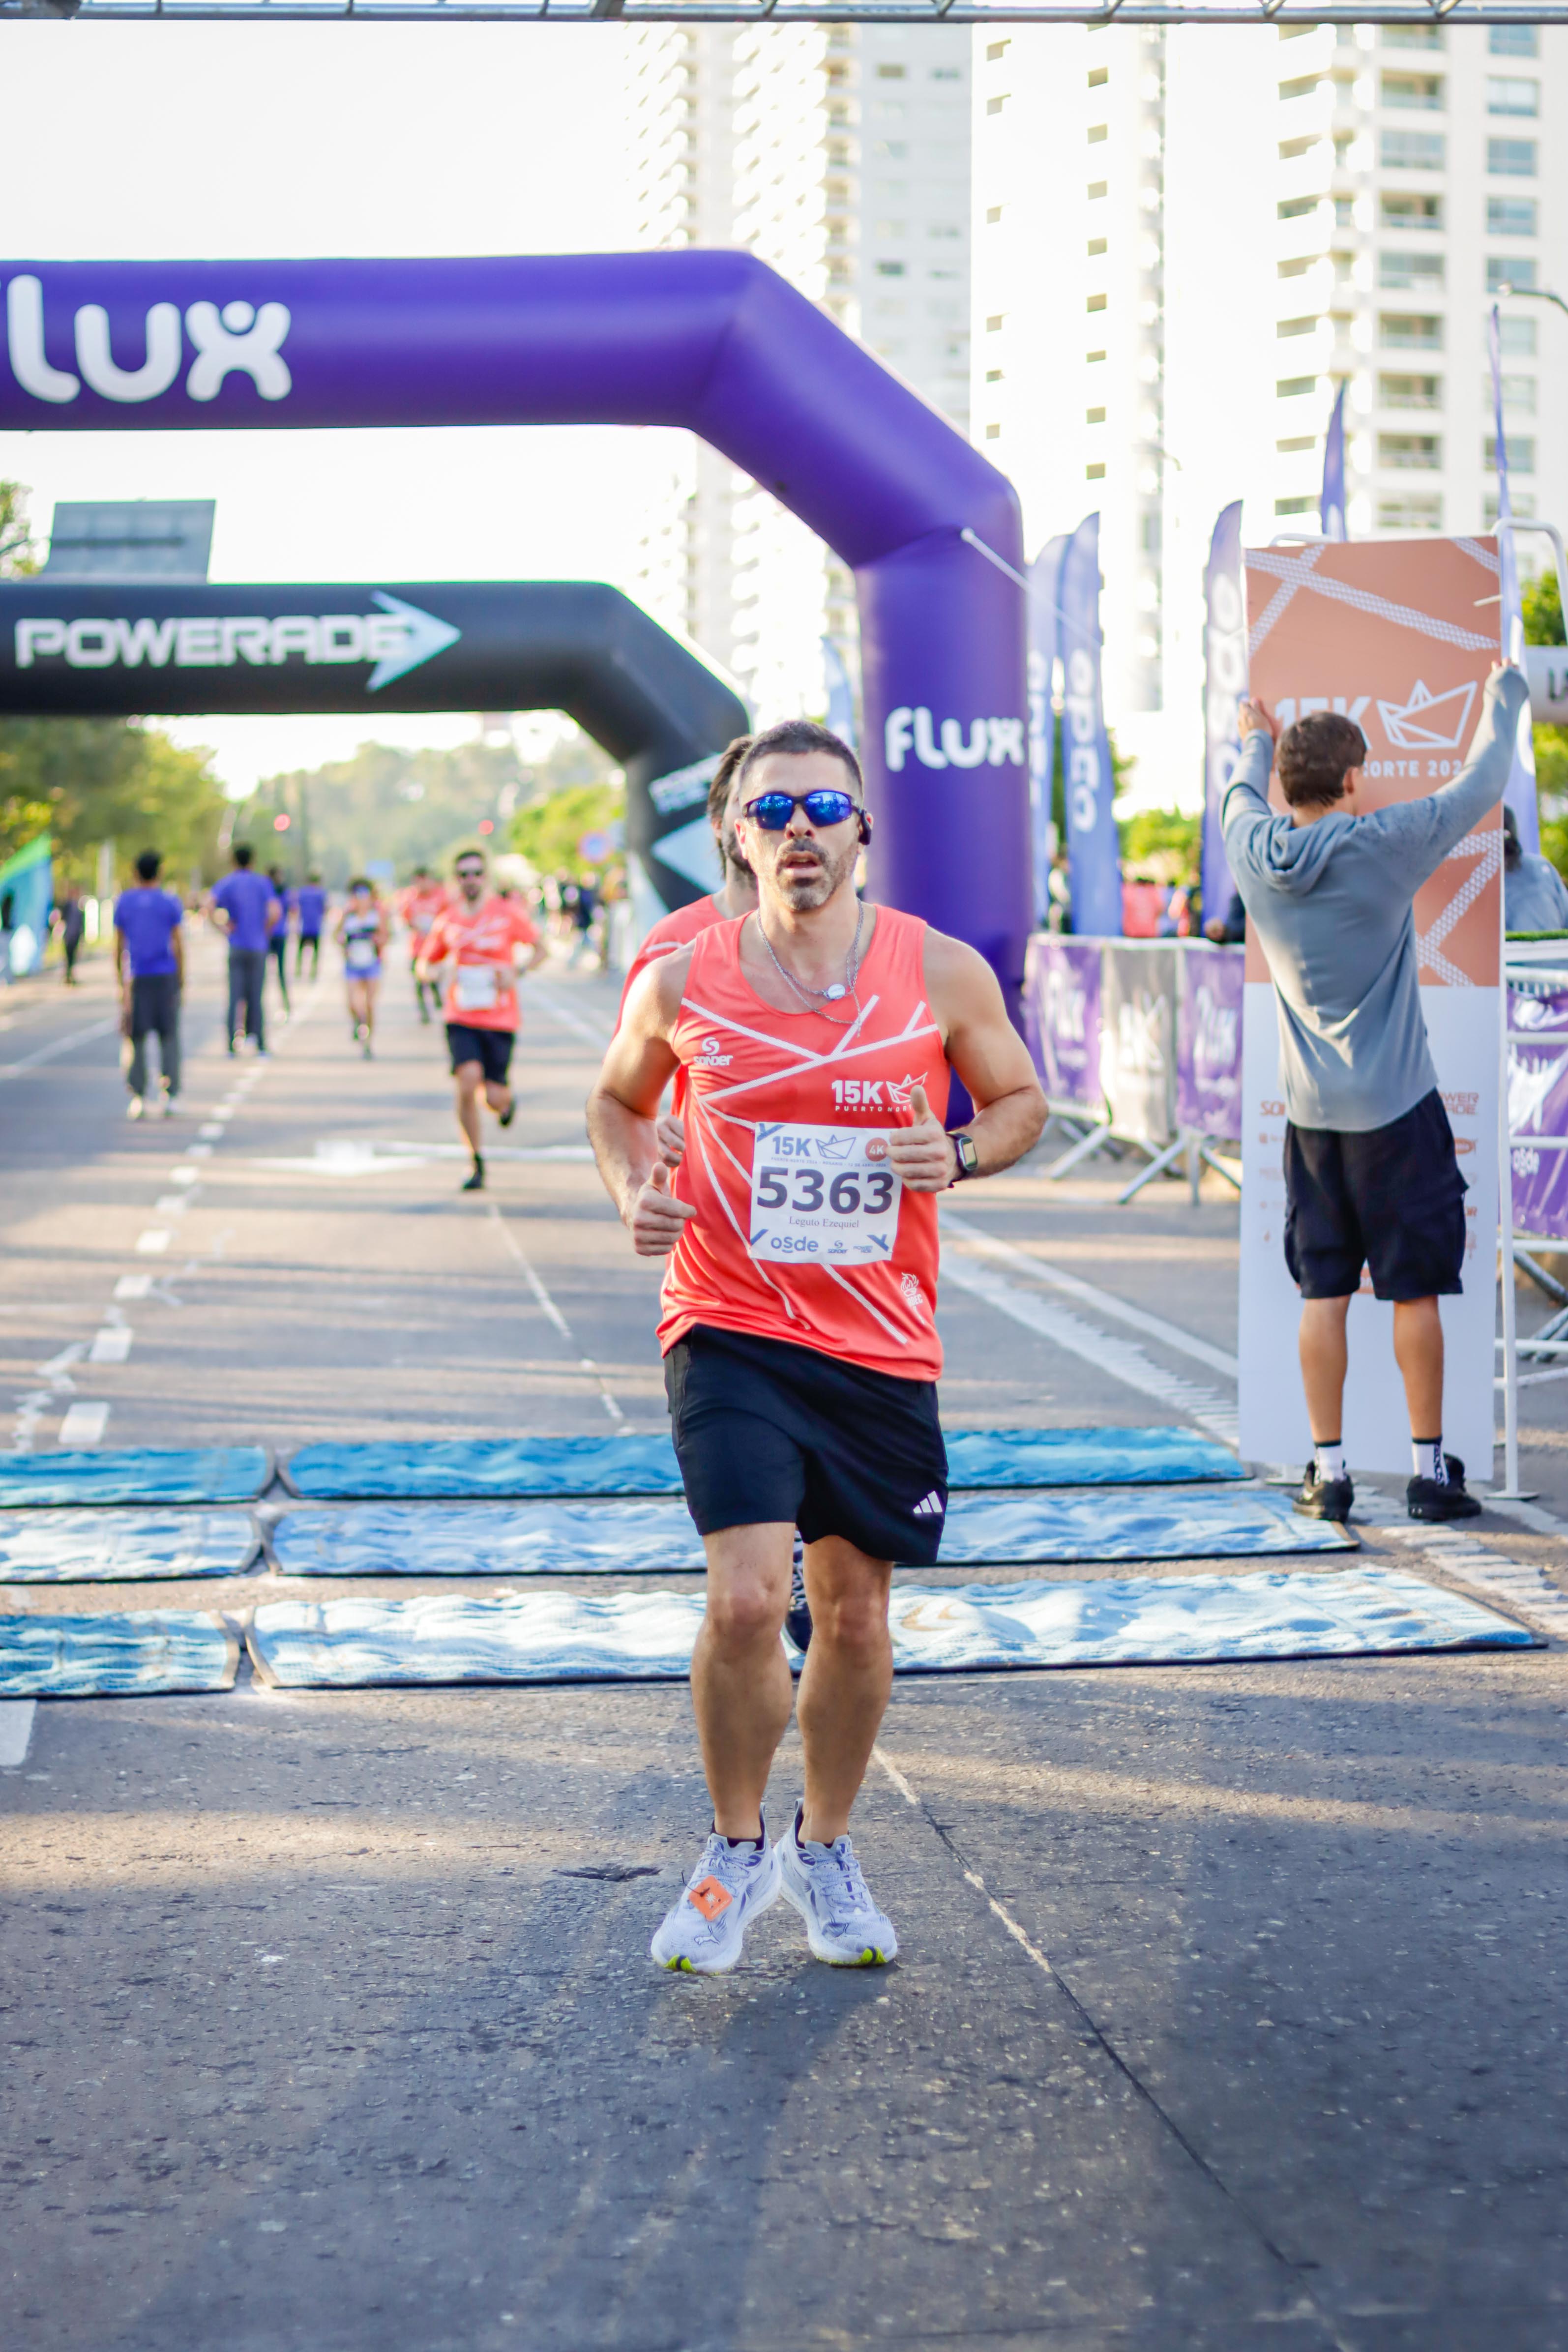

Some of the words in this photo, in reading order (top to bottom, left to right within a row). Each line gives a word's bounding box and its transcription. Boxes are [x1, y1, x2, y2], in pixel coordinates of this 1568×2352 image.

[15, 616, 408, 668] POWERADE
[1427, 760, 1462, 776] 202
[831, 1080, 884, 1104] 15K
[772, 1135, 812, 1157] 15K
[868, 1144, 884, 1155] 4K
[756, 1165, 894, 1214] 5363
[789, 1216, 820, 1228] Leguto
[823, 1218, 859, 1230] Ezequiel
[770, 1235, 819, 1253] osde
